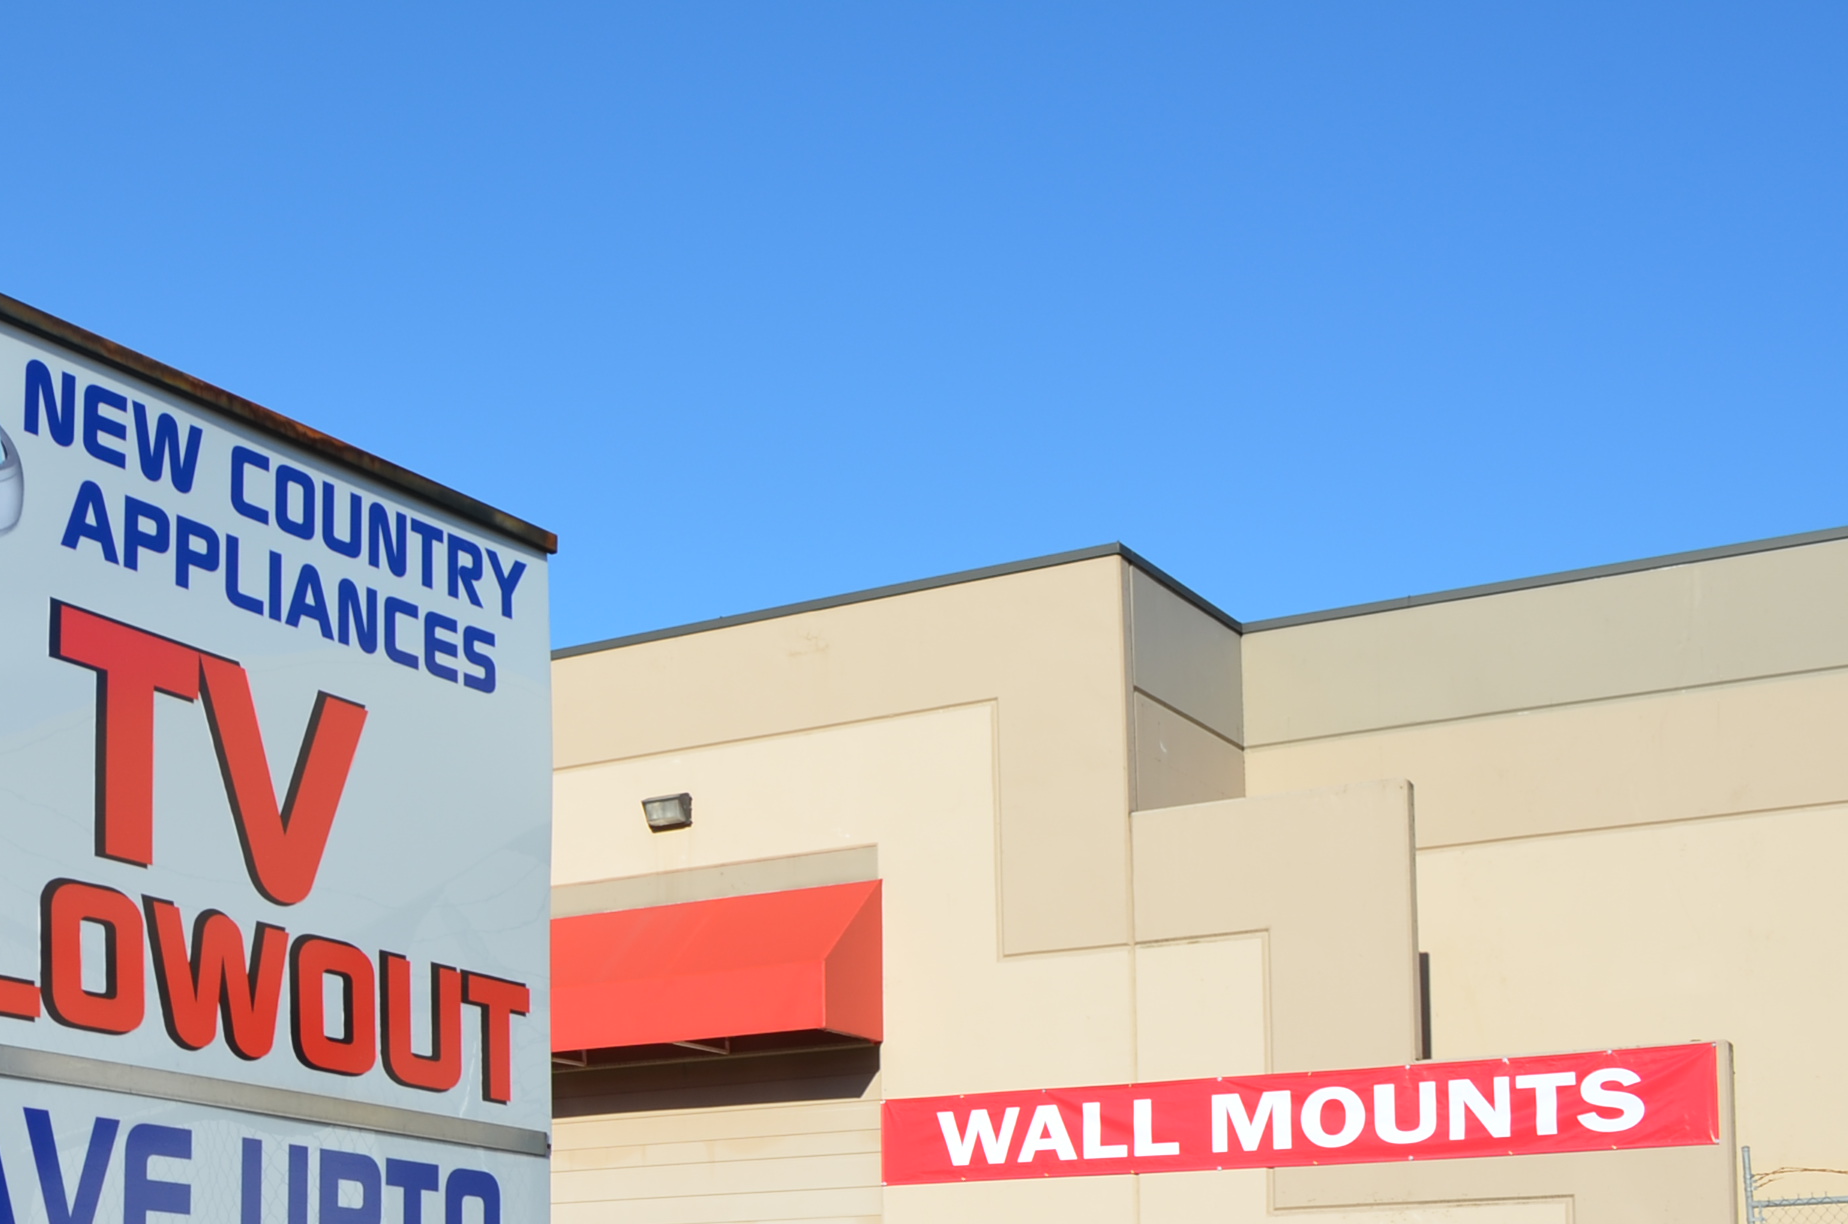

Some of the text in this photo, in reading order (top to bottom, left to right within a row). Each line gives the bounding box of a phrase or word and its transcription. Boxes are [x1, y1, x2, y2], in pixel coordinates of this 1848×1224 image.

[23, 358, 527, 620] NEW COUNTRY
[60, 479, 497, 694] APPLIANCES
[48, 596, 368, 907] TV
[935, 1066, 1647, 1168] WALL MOUNTS
